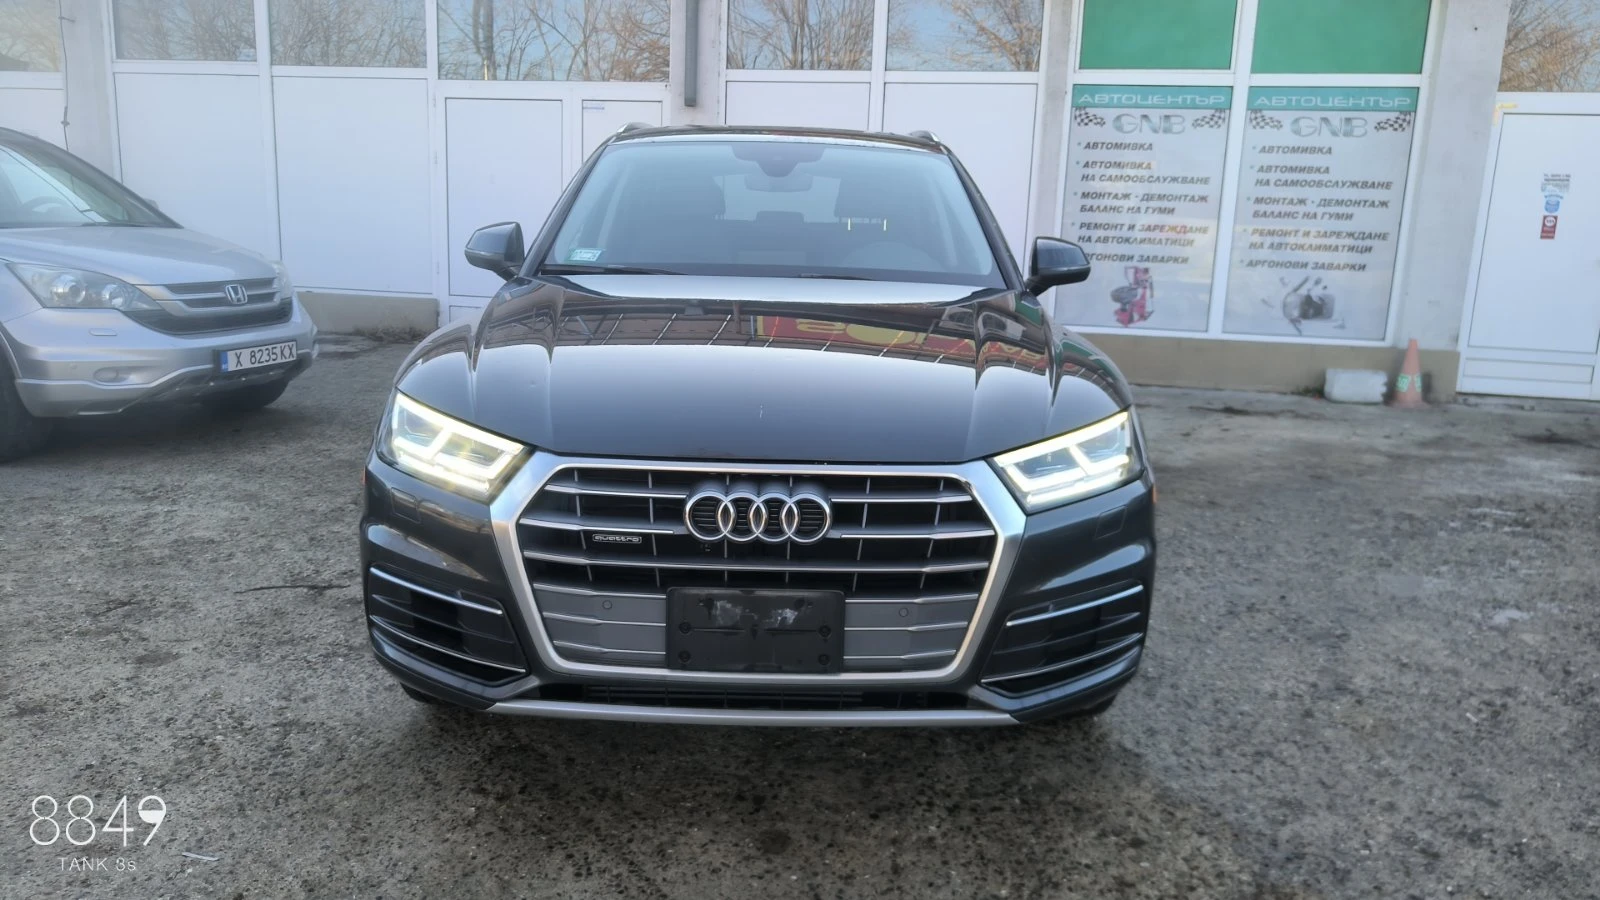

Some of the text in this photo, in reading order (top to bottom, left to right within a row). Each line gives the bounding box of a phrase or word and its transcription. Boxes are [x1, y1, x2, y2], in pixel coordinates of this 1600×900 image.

[1079, 94, 1225, 105] АВТОЦЕНТЪР
[1253, 96, 1411, 108] АВТОЦЕНТЪР
[1112, 113, 1186, 135] GNB
[1290, 116, 1368, 138] GNB
[1083, 141, 1153, 151] АВТОМИВКА
[1258, 145, 1333, 155] АВТОМИВКА
[1082, 160, 1152, 170] АВТОМИВКА
[1256, 164, 1330, 175] АВТОМИВКА
[1081, 173, 1211, 186] НА САМООБСЛУЖВАНЕ
[1254, 178, 1393, 191] НА САМООБСЛУЖВАНЕ
[1080, 191, 1132, 201] МОНТАЖ
[1140, 193, 1209, 203] ДЕМОНТАЖ
[1253, 196, 1307, 207] МОНТАЖ
[1316, 198, 1390, 209] ДЕМОНТАЖ
[1080, 204, 1176, 215] БАЛАНС НА ГУМИ
[1252, 210, 1354, 221] БАЛАНС НА ГУМИ
[1079, 222, 1209, 235] РЕМОНТ И ЗАРЕЖДАНЕ
[1251, 228, 1390, 241] РЕМОНТ И ЗАРЕЖДАНЕ
[1077, 235, 1195, 248] НА АВТОКЛИМАТИЦИ
[1248, 241, 1373, 254] НА АВТОКЛИМАТИЦИ
[1084, 252, 1189, 264] РГОНОВИ ЗАВАРКИ
[1245, 259, 1367, 272] АРГОНОВИ ЗАВАРКИ
[249, 346, 279, 365] 8235
[280, 344, 295, 360] KX
